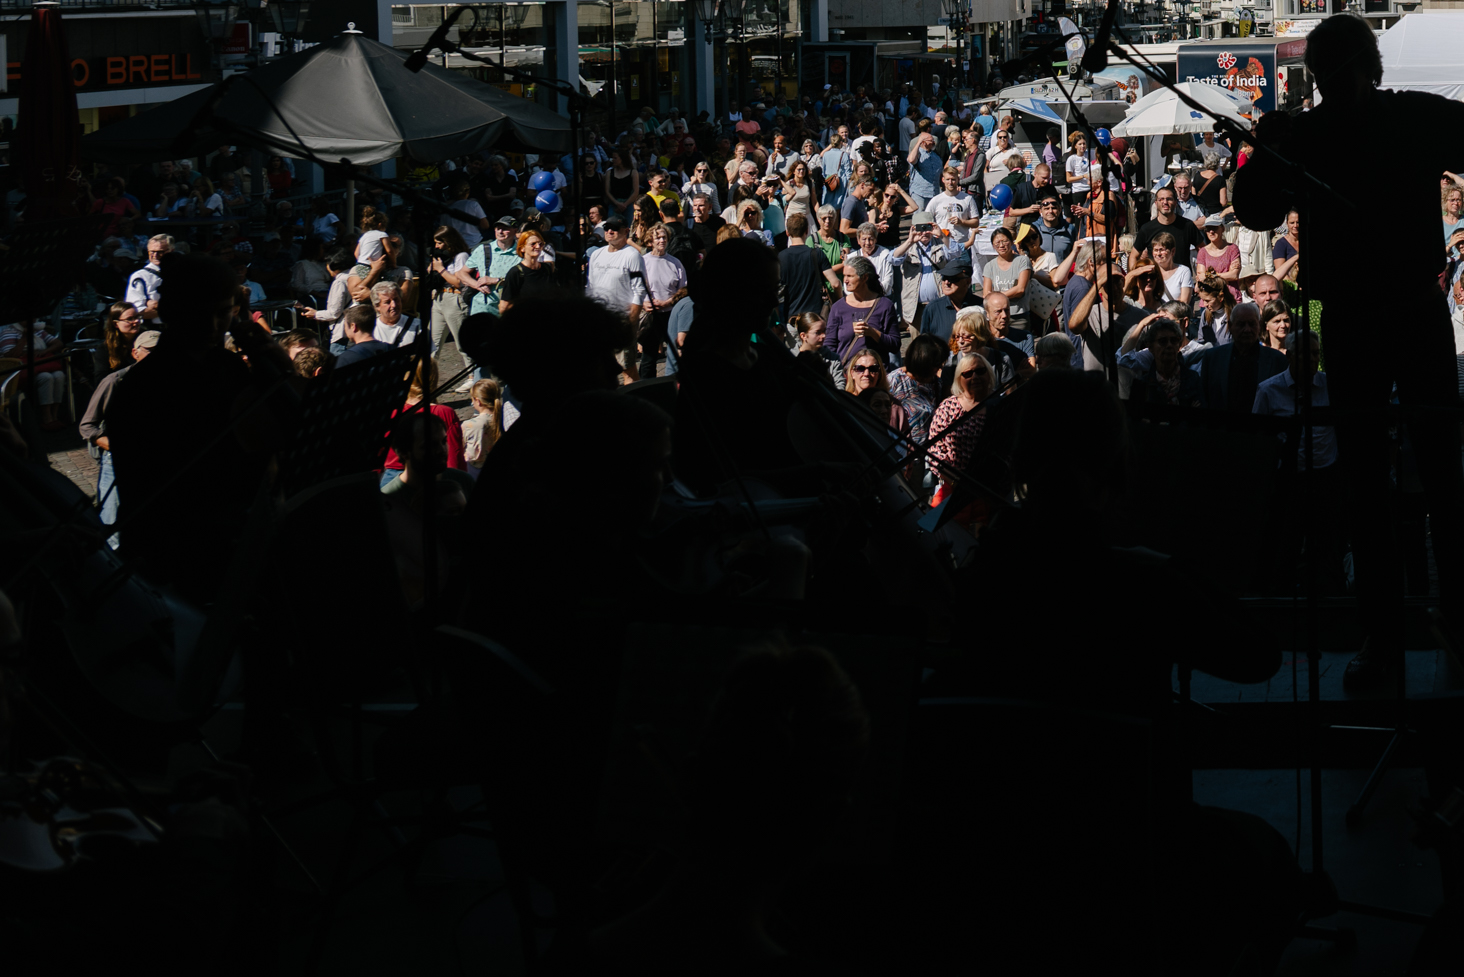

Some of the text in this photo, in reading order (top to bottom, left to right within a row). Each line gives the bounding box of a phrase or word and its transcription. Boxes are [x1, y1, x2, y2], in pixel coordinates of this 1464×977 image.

[107, 54, 201, 85] BRELL
[1186, 75, 1267, 87] Taste of India
